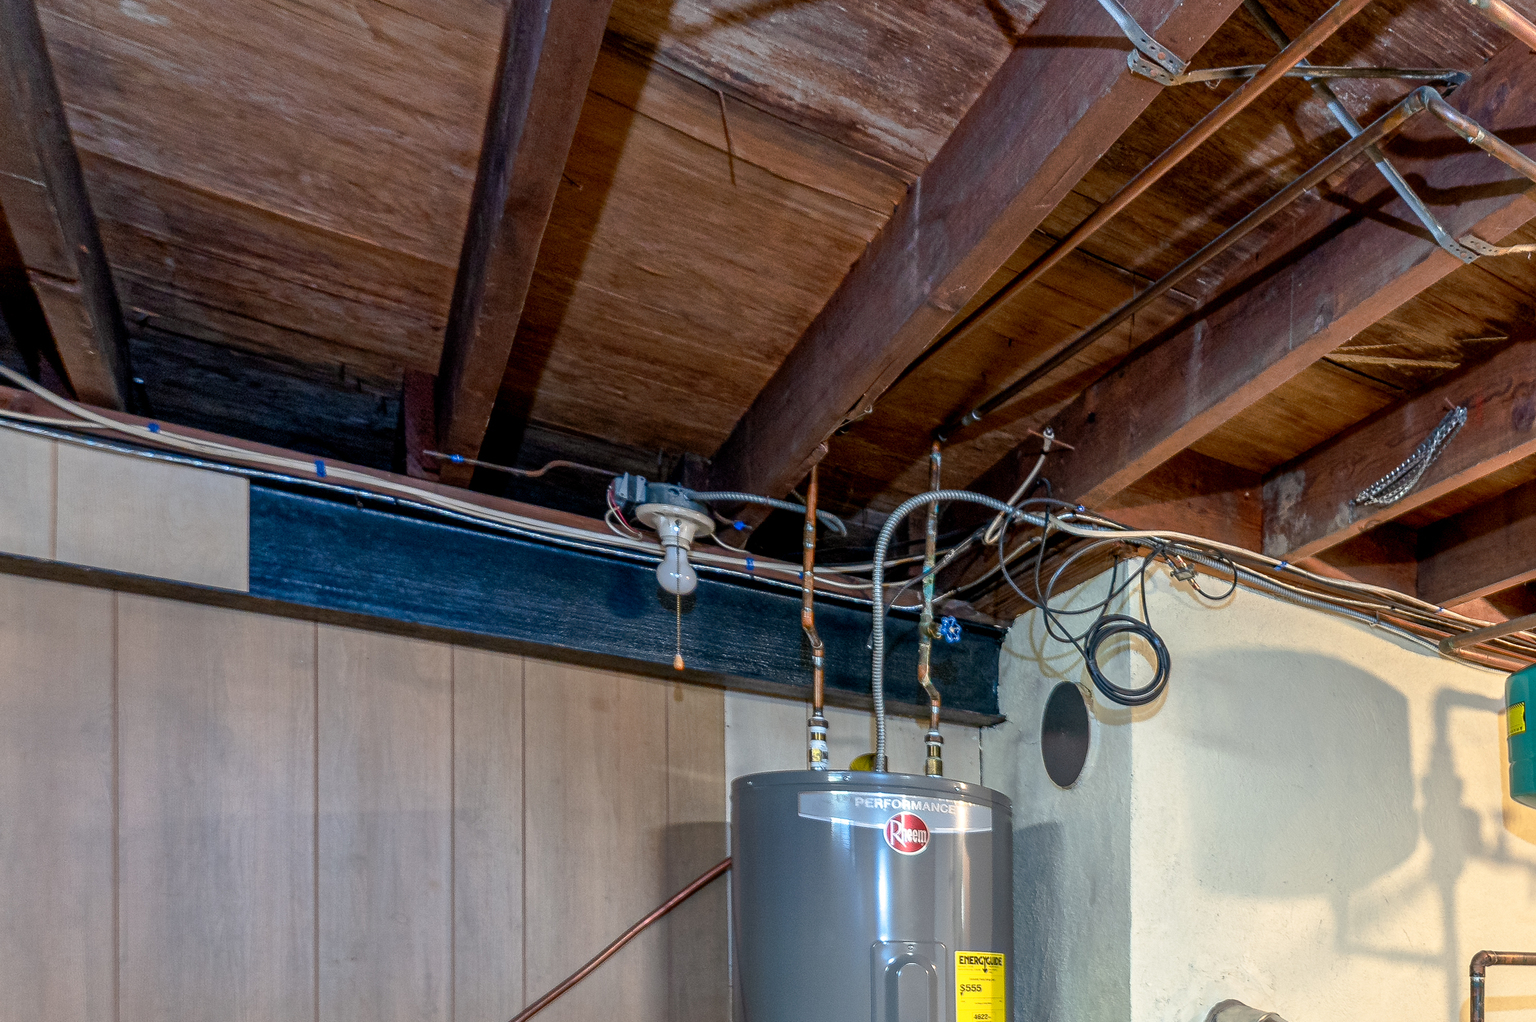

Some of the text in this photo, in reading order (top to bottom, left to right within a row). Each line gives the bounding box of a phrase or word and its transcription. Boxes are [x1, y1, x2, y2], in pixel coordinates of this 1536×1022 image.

[855, 797, 956, 814] PERFORMANCE
[890, 812, 927, 848] Rheem
[960, 984, 982, 992] $555
